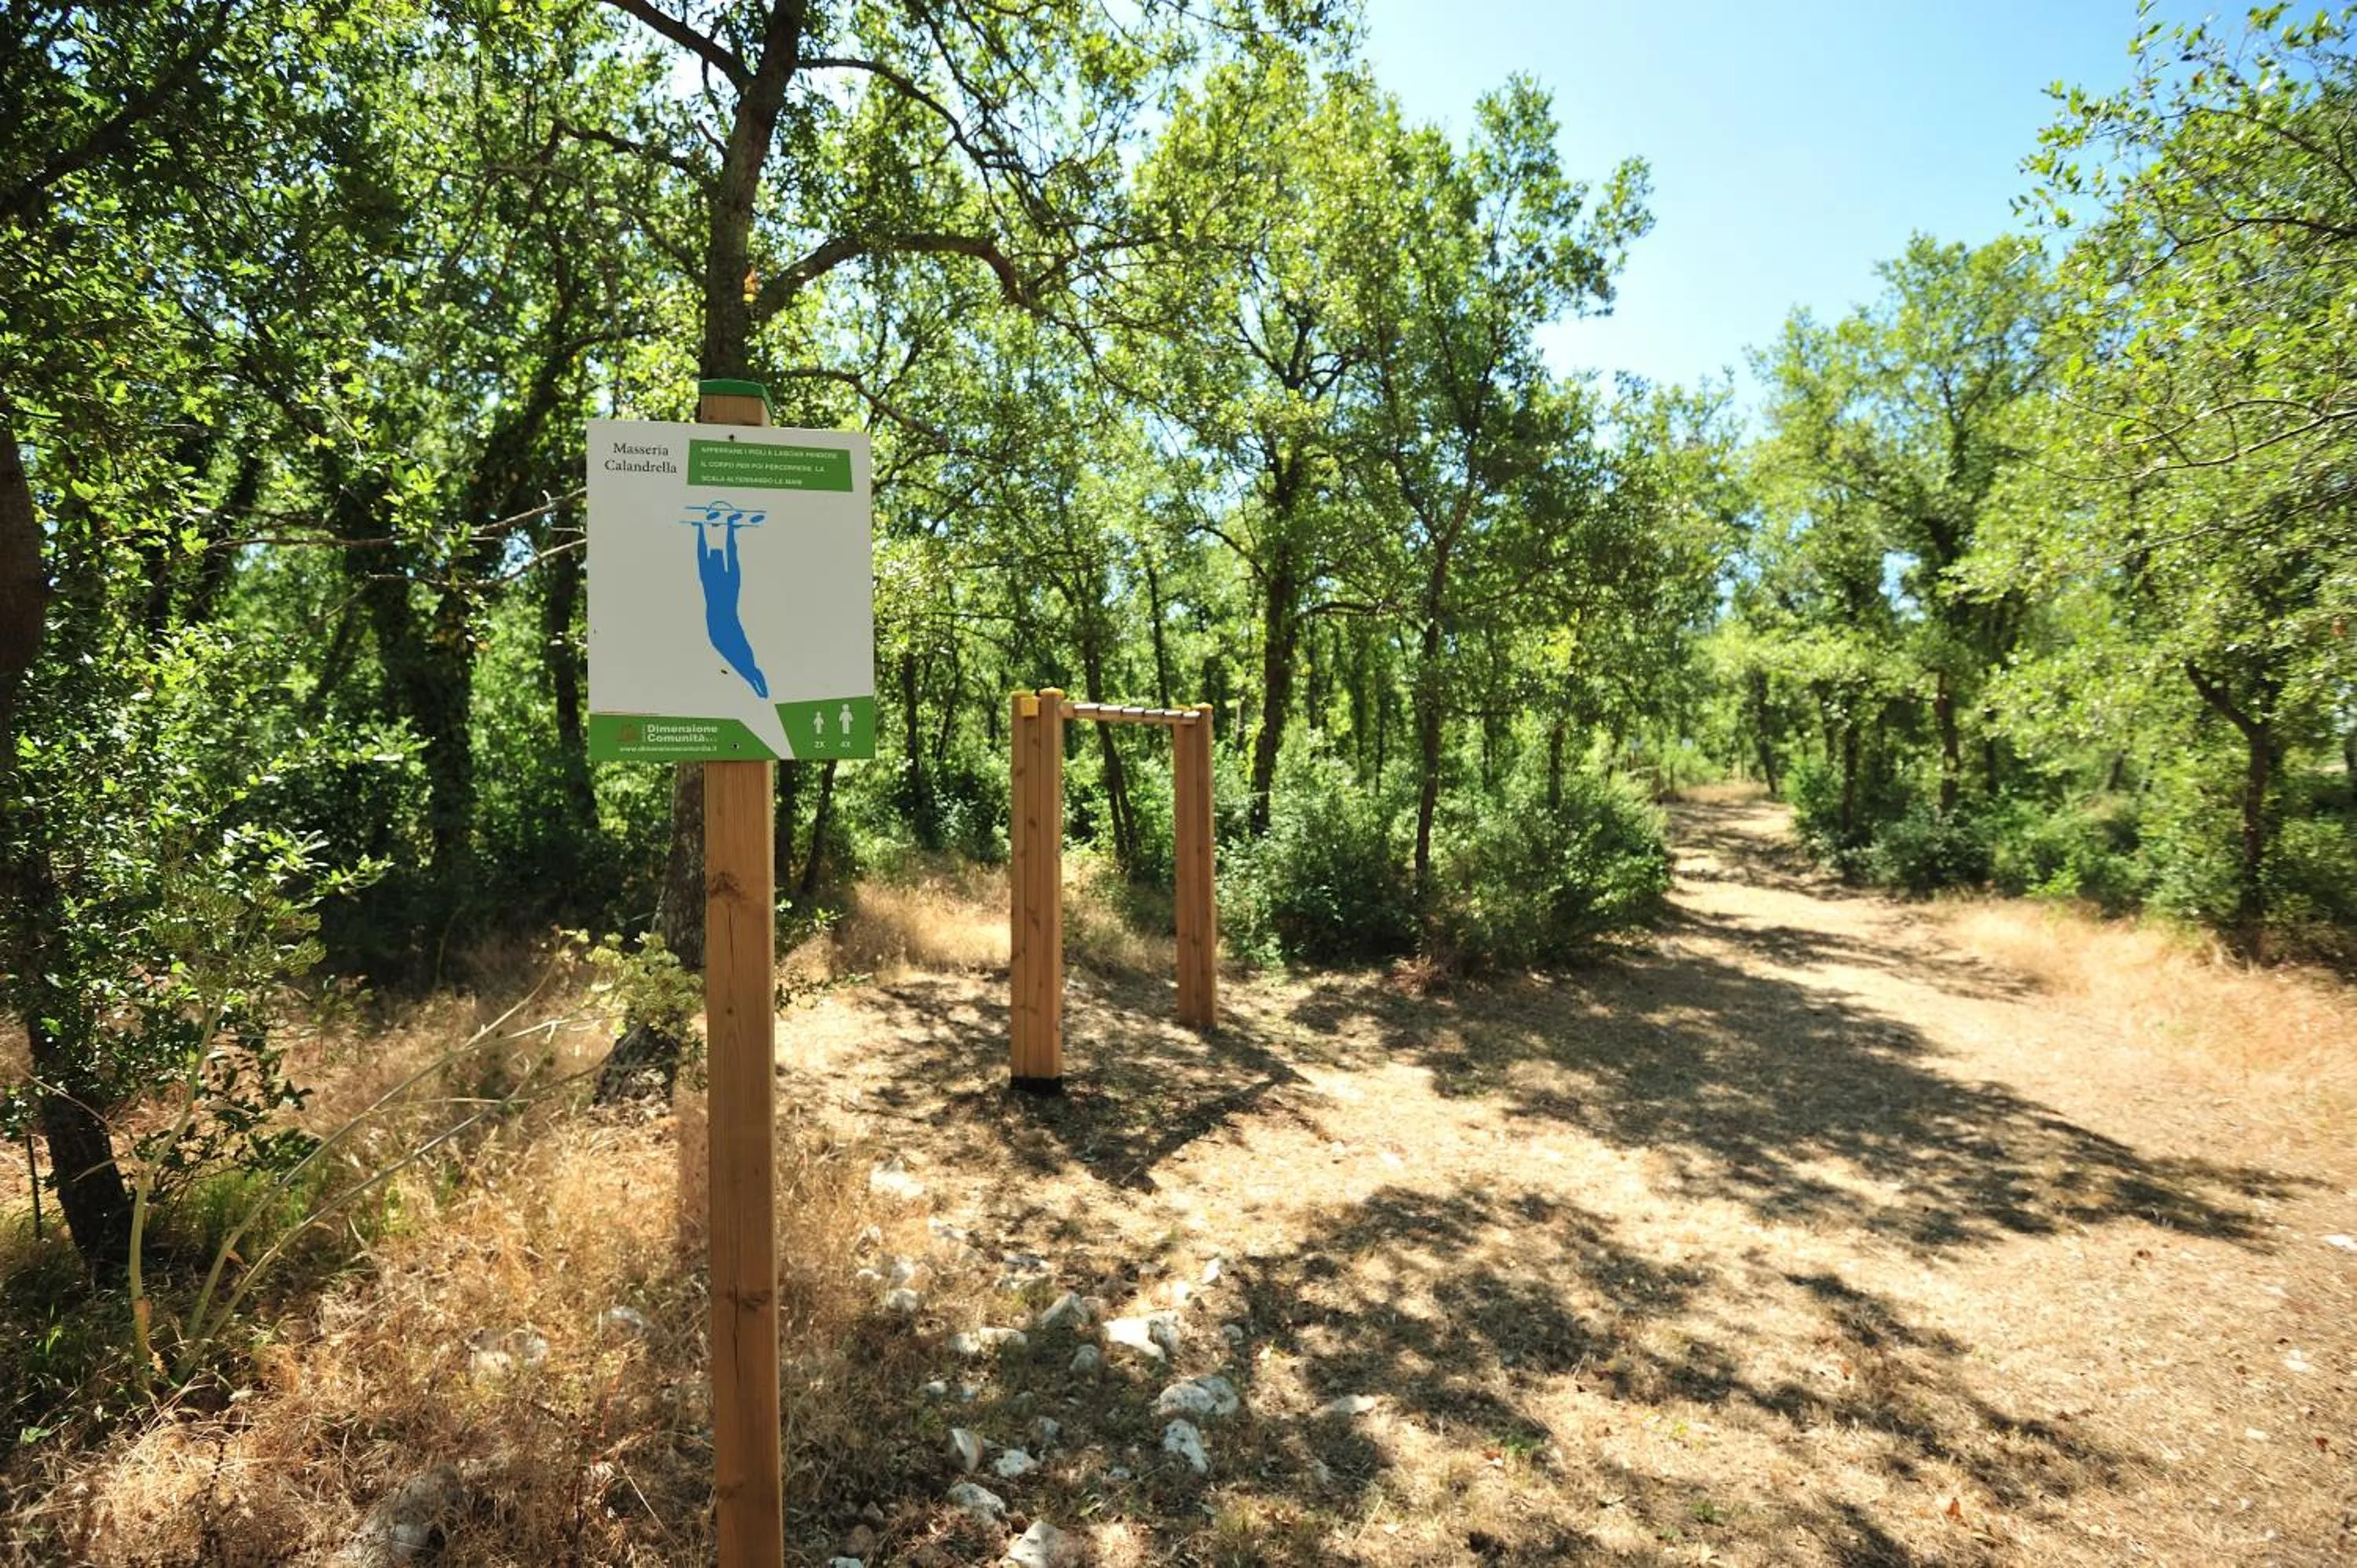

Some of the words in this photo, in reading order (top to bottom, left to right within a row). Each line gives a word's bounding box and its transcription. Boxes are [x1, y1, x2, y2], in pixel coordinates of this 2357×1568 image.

[613, 442, 669, 456] Masseria
[604, 459, 677, 474] Calandrella
[647, 724, 718, 733] Dimensione
[647, 733, 706, 742] Comunità
